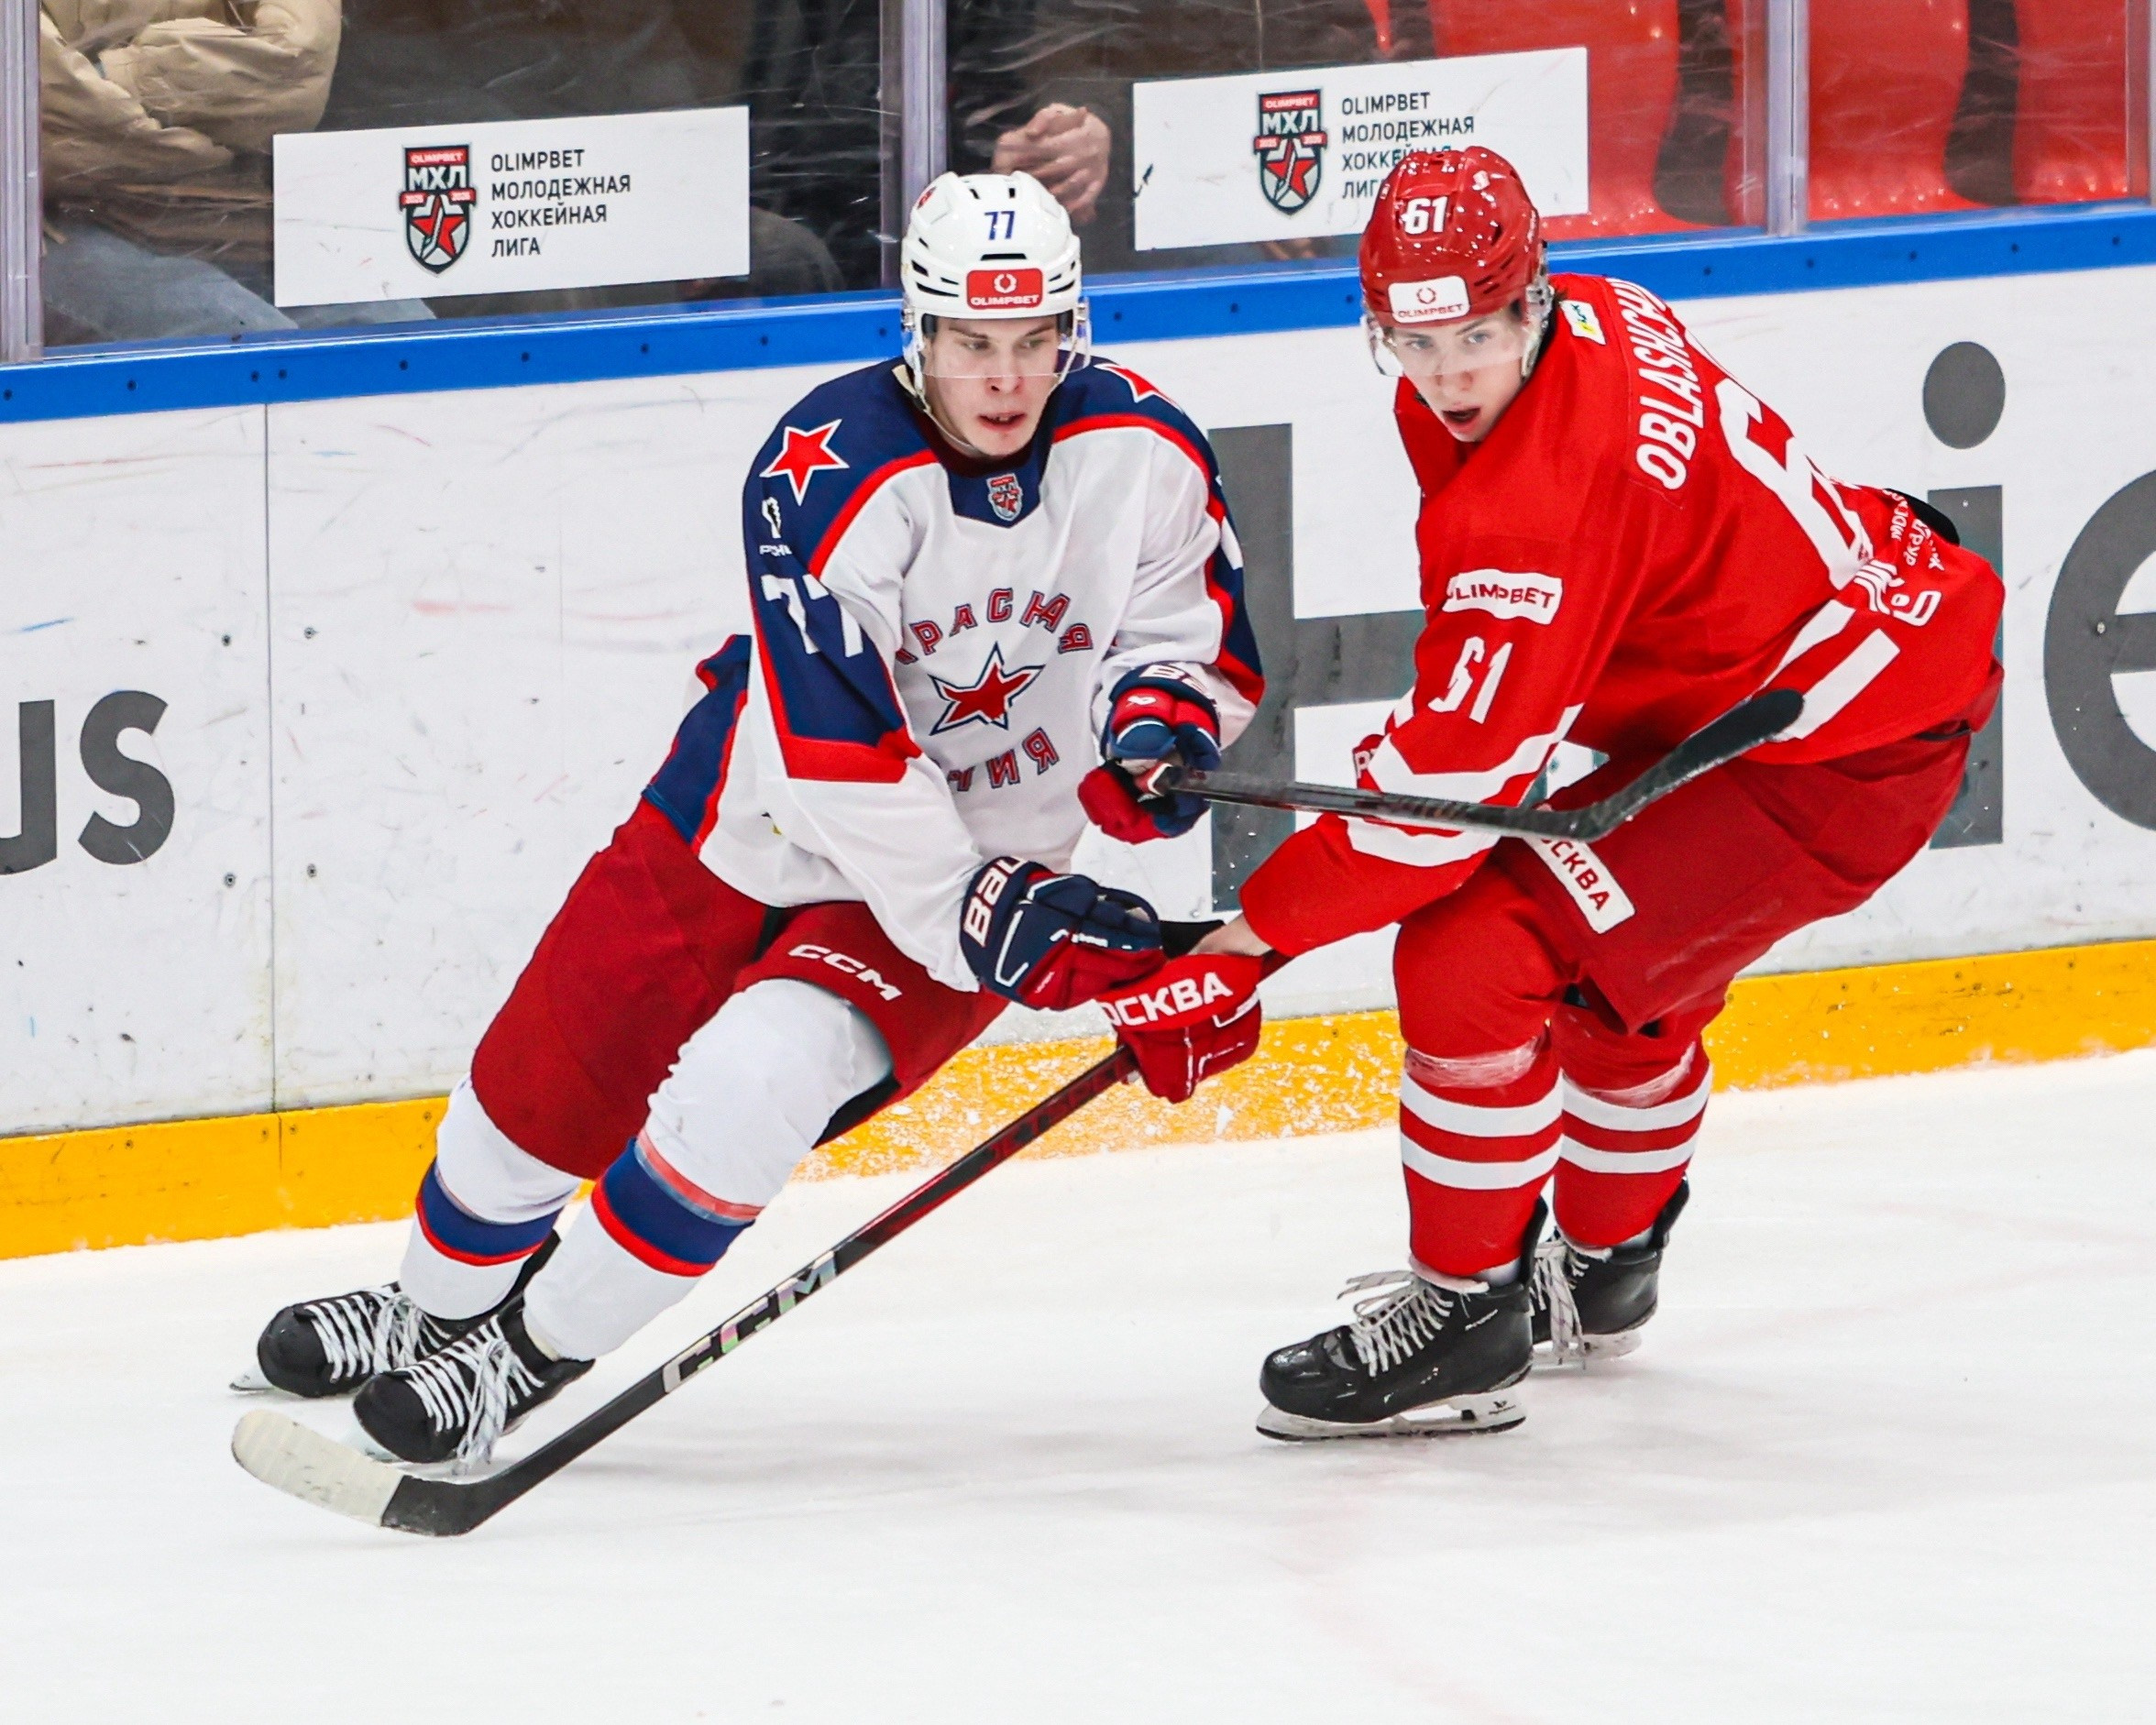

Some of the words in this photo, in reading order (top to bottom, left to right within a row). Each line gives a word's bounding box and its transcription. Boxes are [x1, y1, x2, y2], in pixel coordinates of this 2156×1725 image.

[1342, 92, 1430, 115] OLIMPBET
[1262, 109, 1318, 136] МХЛ
[1342, 116, 1475, 144] МОЛОДЕЖНАЯ
[491, 148, 585, 172] OLIMPBET
[1342, 144, 1451, 171] ХОККЕ
[409, 165, 467, 192] МХЛ
[491, 174, 631, 201] МОЛОДЕЖНАЯ
[1342, 179, 1380, 199] ЛИГ
[491, 202, 607, 230] ХОККЕЙНАЯ
[984, 211, 1015, 240] 77
[1404, 196, 1448, 235] 61
[491, 236, 541, 258] ЛИГА
[971, 294, 1040, 306] OLIMPBET
[1448, 584, 1555, 609] LIMPBET
[761, 574, 864, 658] 77
[896, 588, 1094, 665] РАСНАЯ
[1542, 838, 1611, 912] СКВА
[787, 944, 903, 1001] CCM
[661, 1250, 837, 1394] CCM
